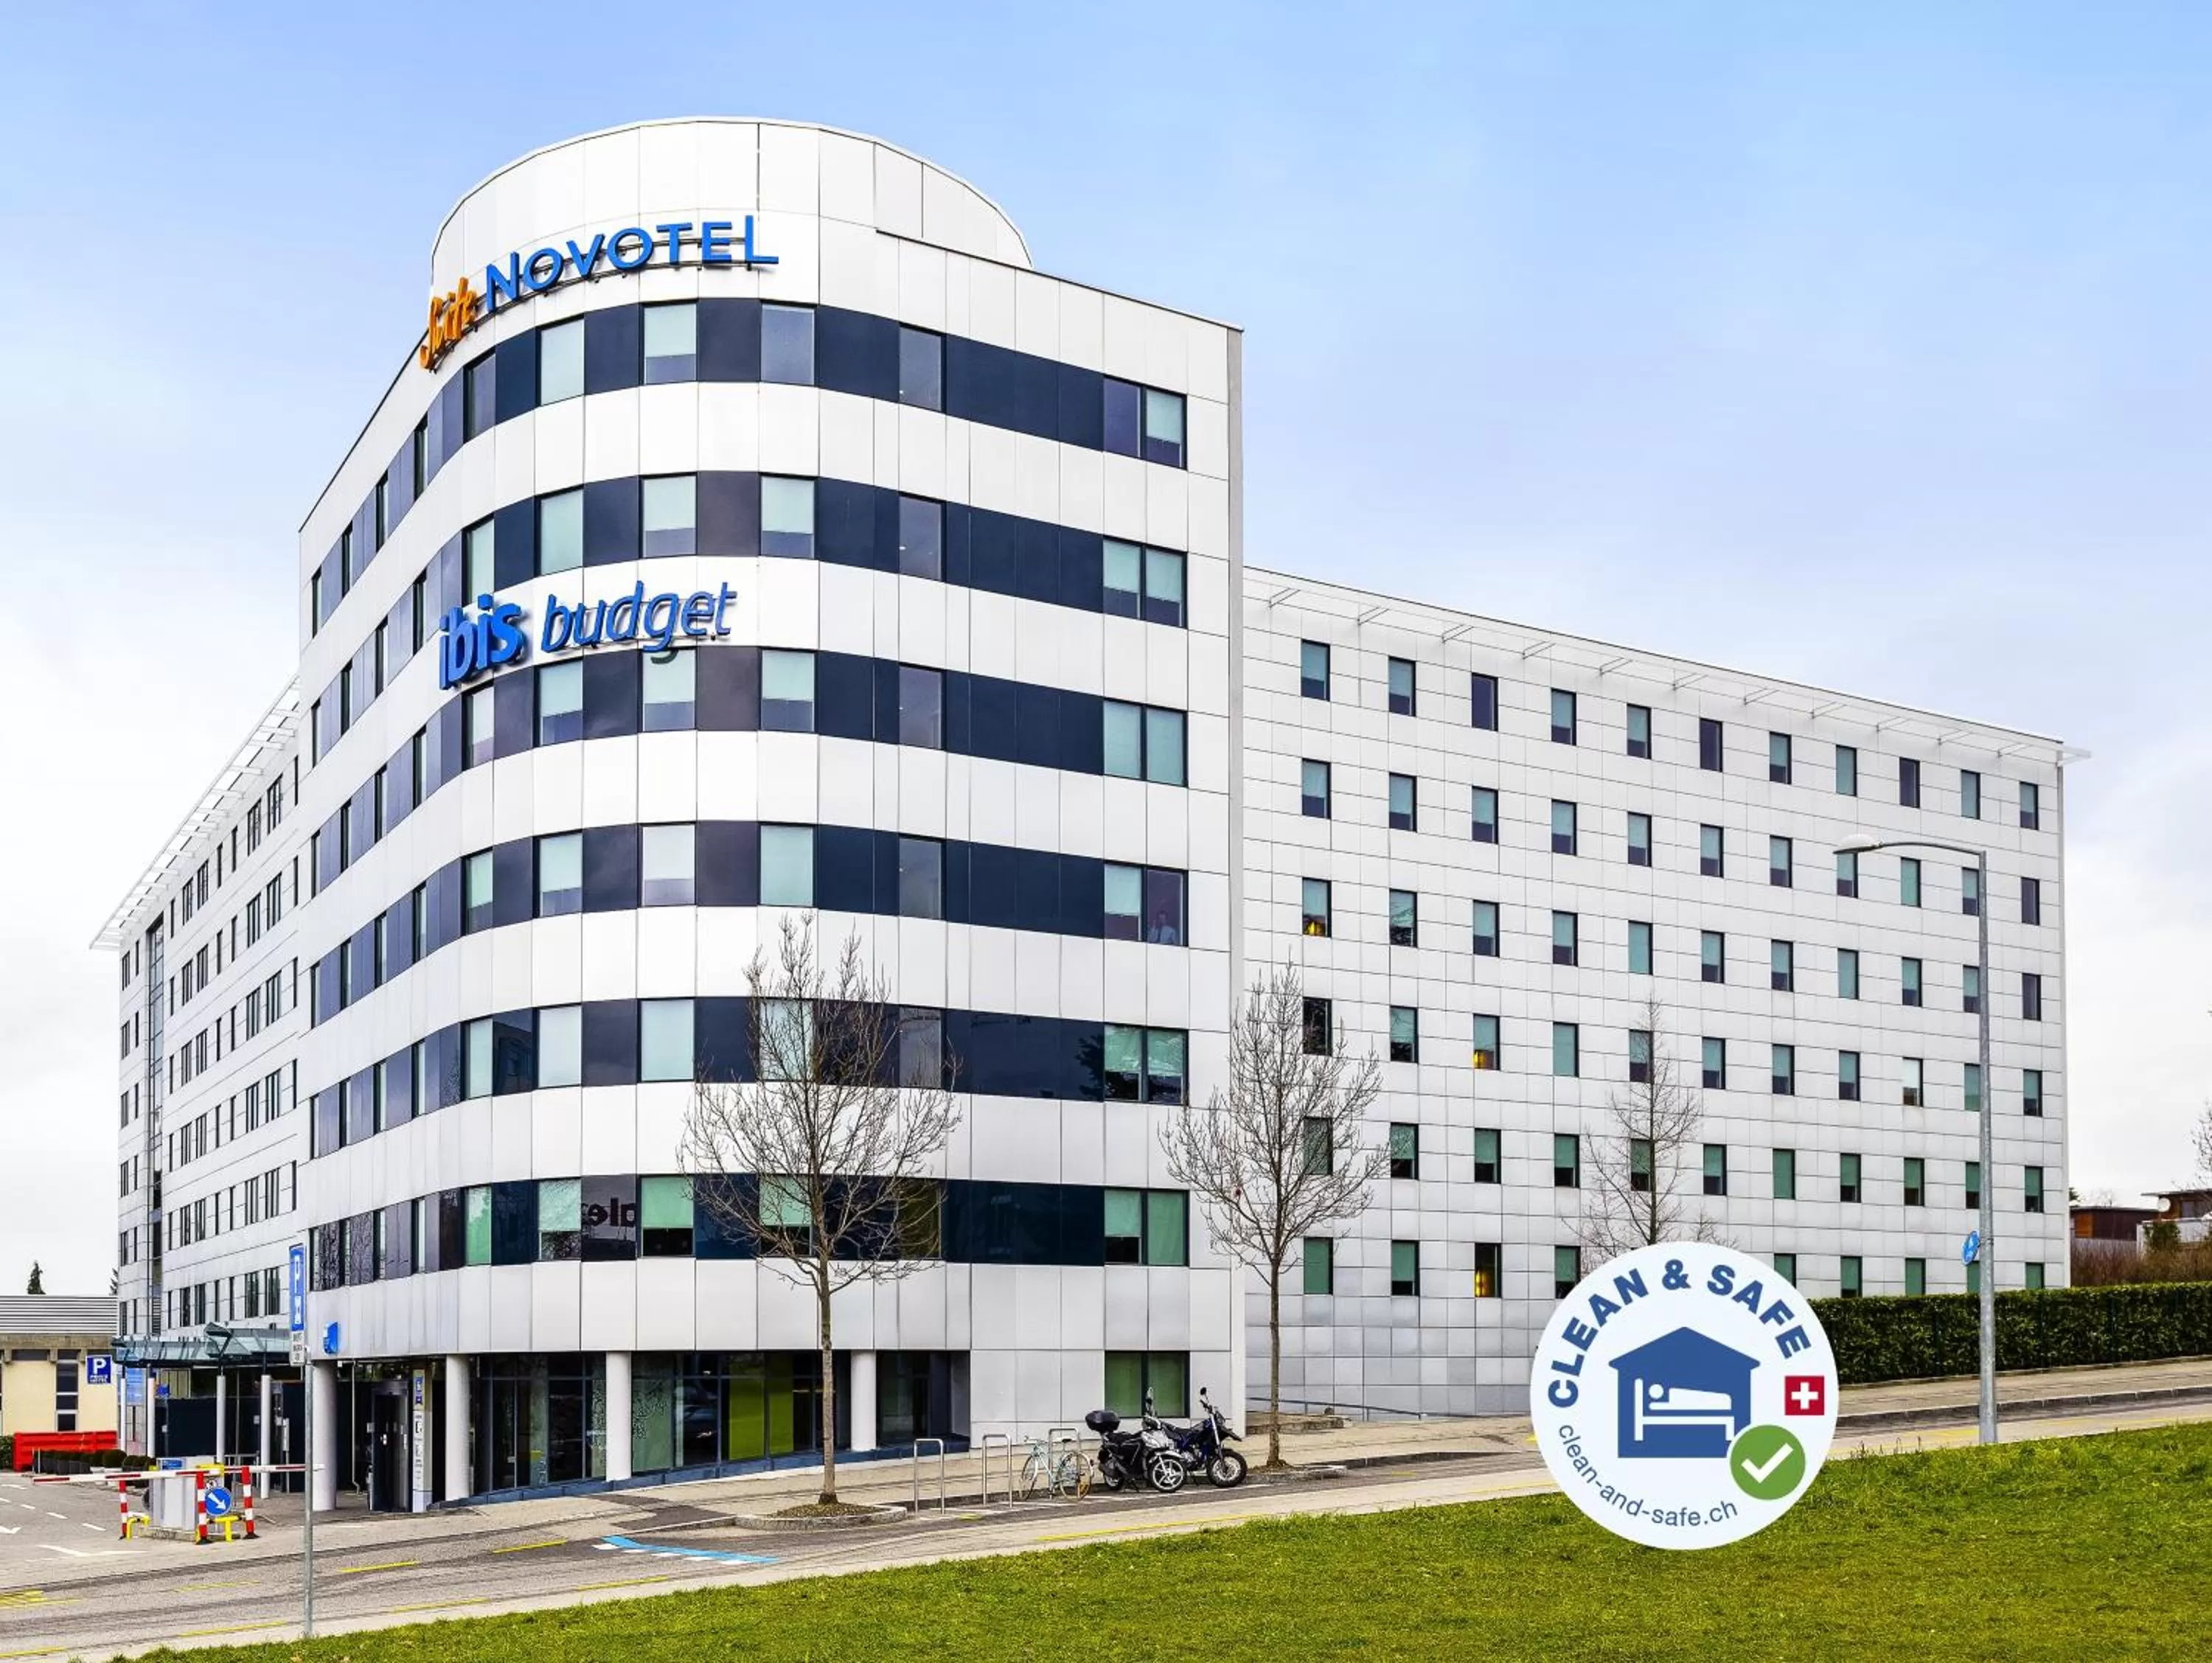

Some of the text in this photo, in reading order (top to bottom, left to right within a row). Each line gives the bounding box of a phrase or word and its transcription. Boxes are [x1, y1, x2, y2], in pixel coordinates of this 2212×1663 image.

[420, 215, 779, 370] Suite NOVOTEL
[439, 579, 737, 690] ibis budget
[93, 1358, 107, 1375] P
